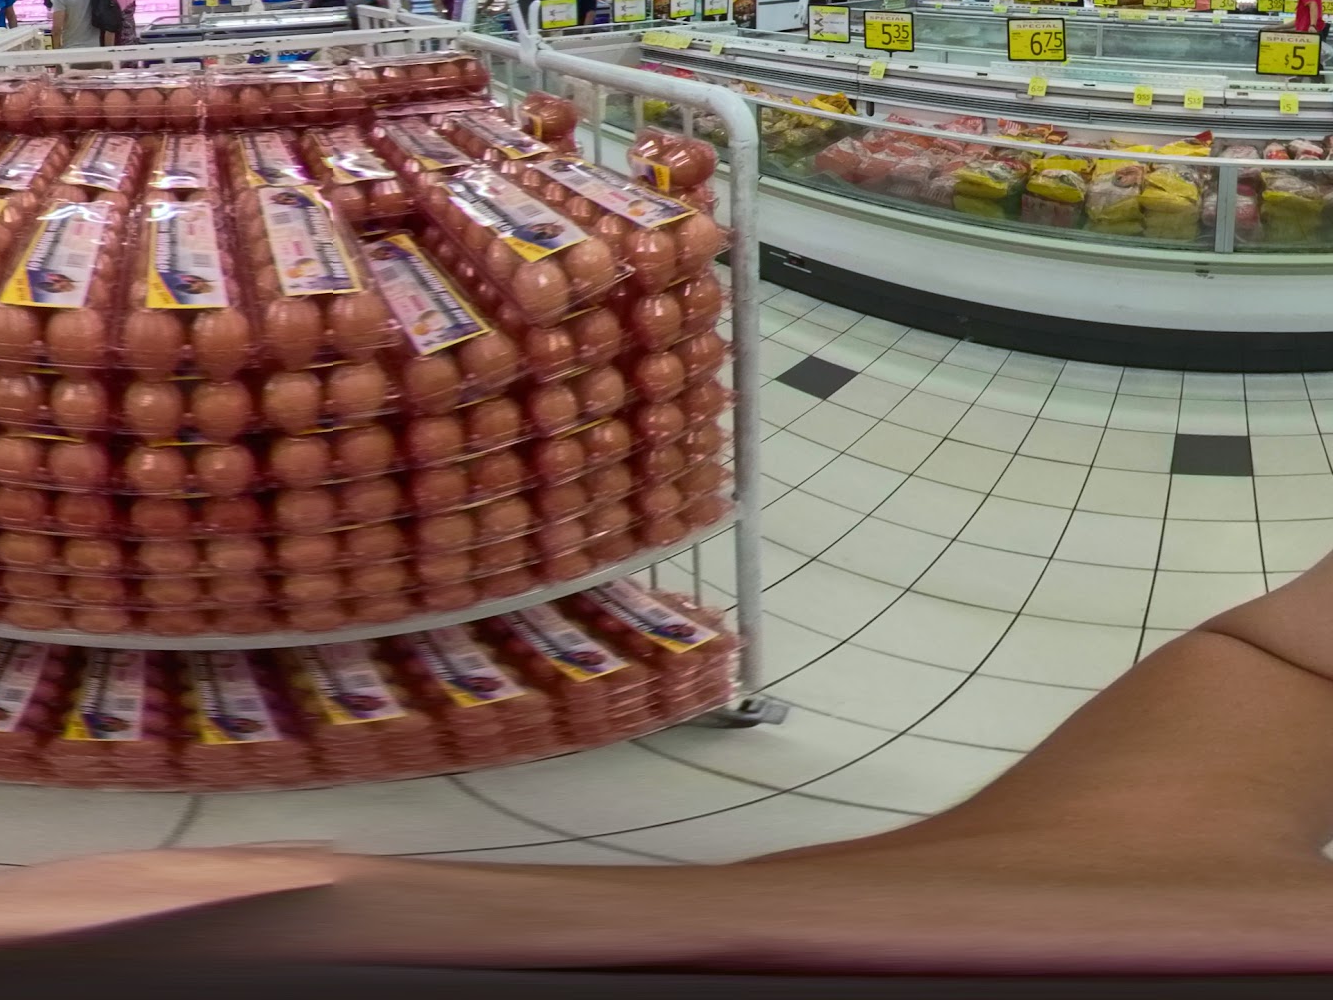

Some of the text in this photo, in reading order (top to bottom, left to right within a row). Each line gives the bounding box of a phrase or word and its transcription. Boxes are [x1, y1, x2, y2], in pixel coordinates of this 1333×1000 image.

[881, 24, 910, 45] 5.35
[1030, 32, 1063, 56] 6.75
[1284, 45, 1306, 70] $5
